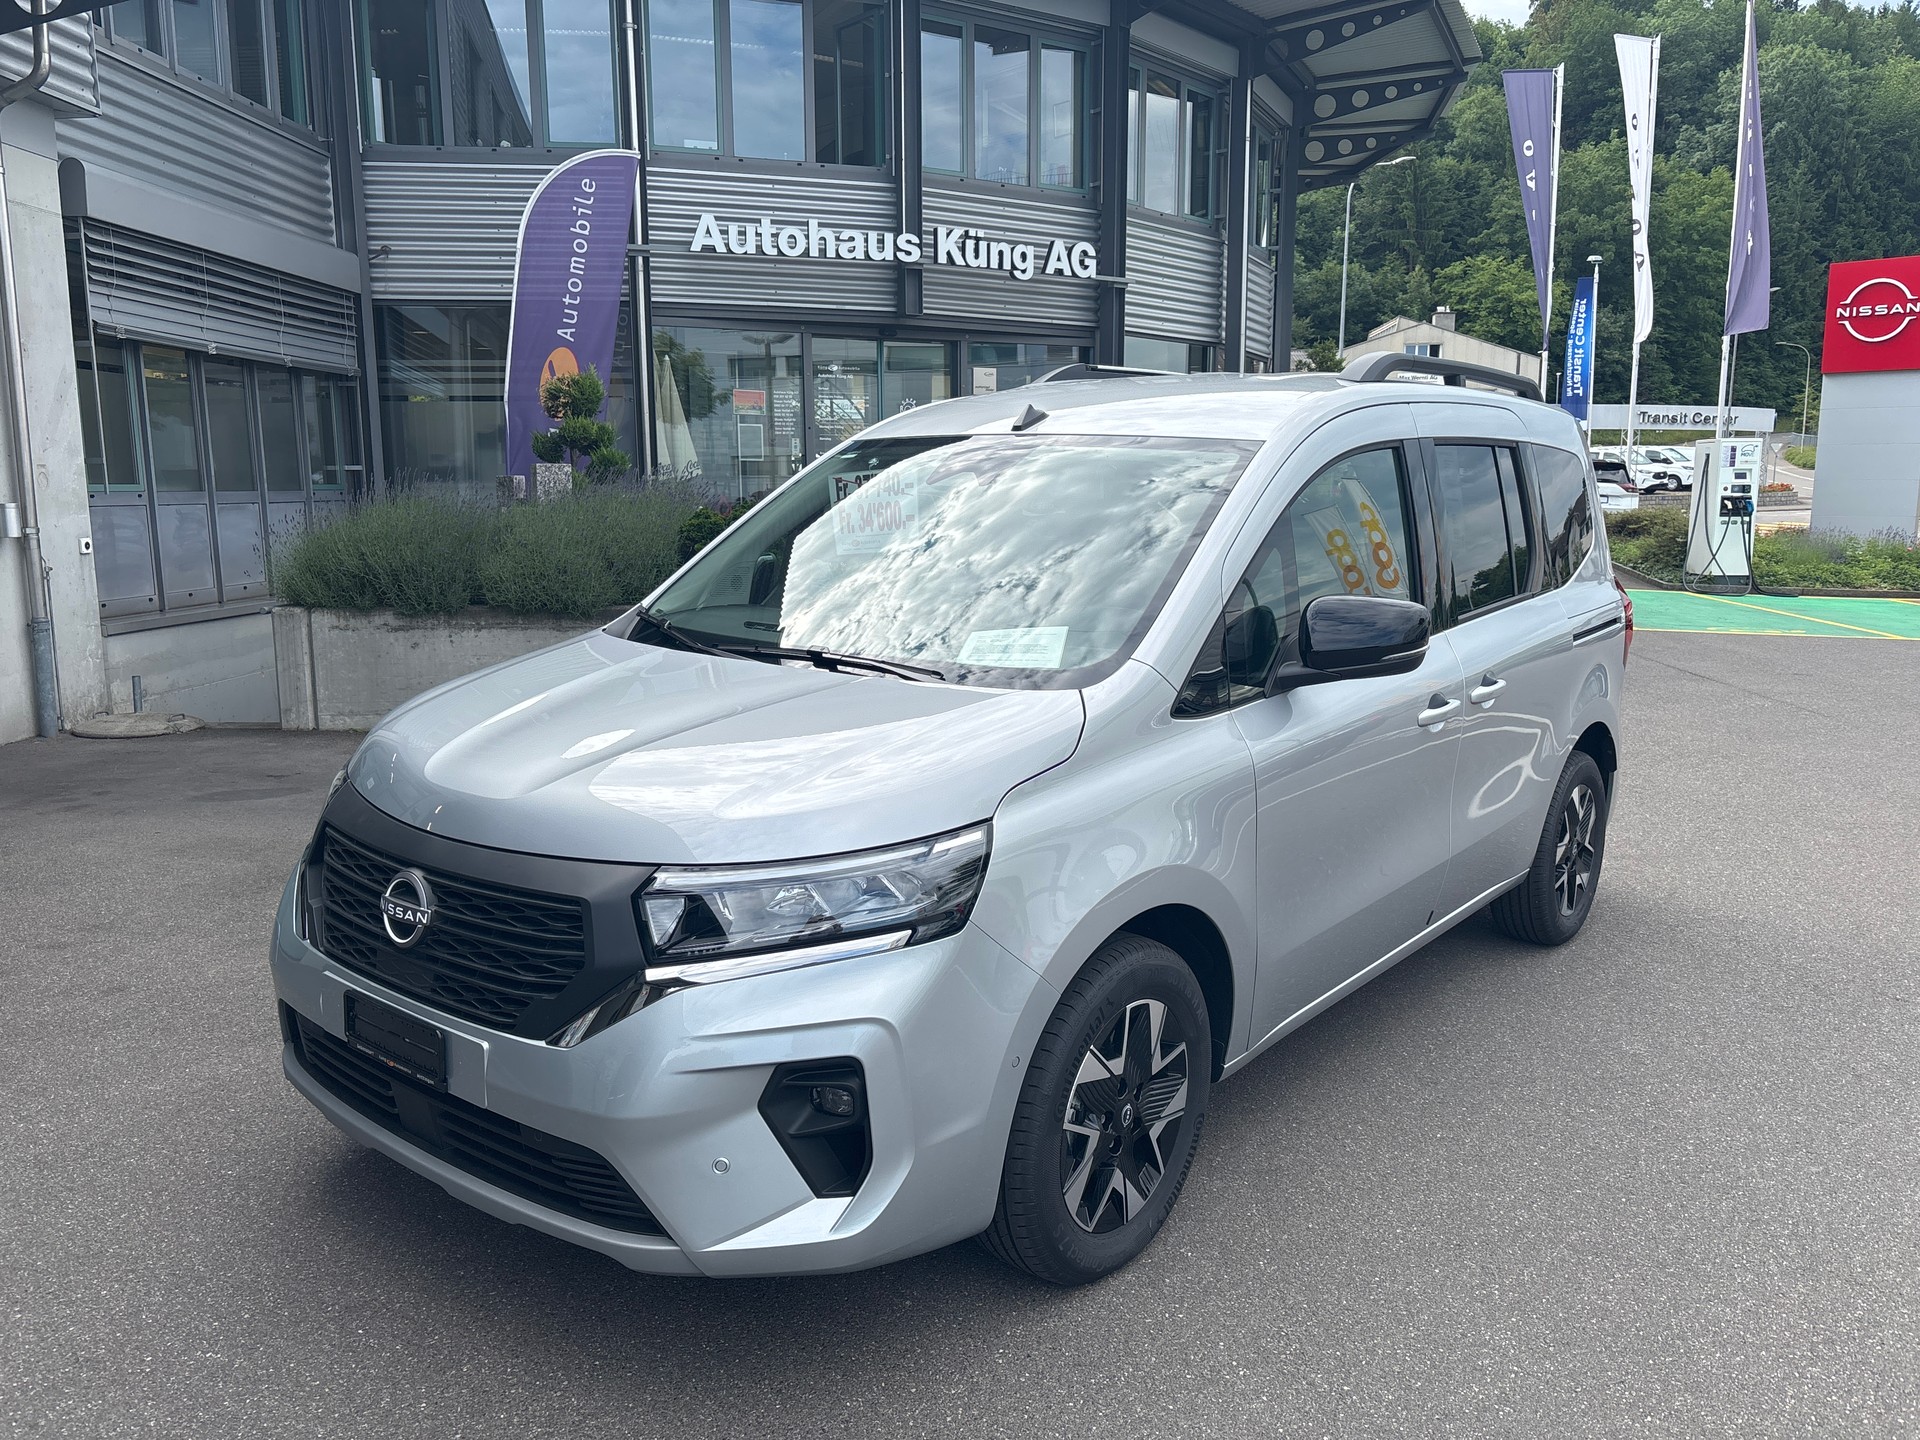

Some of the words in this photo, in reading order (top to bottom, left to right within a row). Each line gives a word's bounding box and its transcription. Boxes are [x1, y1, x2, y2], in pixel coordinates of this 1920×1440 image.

[556, 178, 596, 342] Automobile
[689, 213, 922, 263] Autohaus
[934, 226, 1035, 280] Küng
[1044, 239, 1097, 278] AG
[1836, 302, 1920, 318] NISSAN
[1639, 411, 1688, 424] Transit
[1691, 412, 1739, 425] Cener
[839, 505, 856, 534] Fr.
